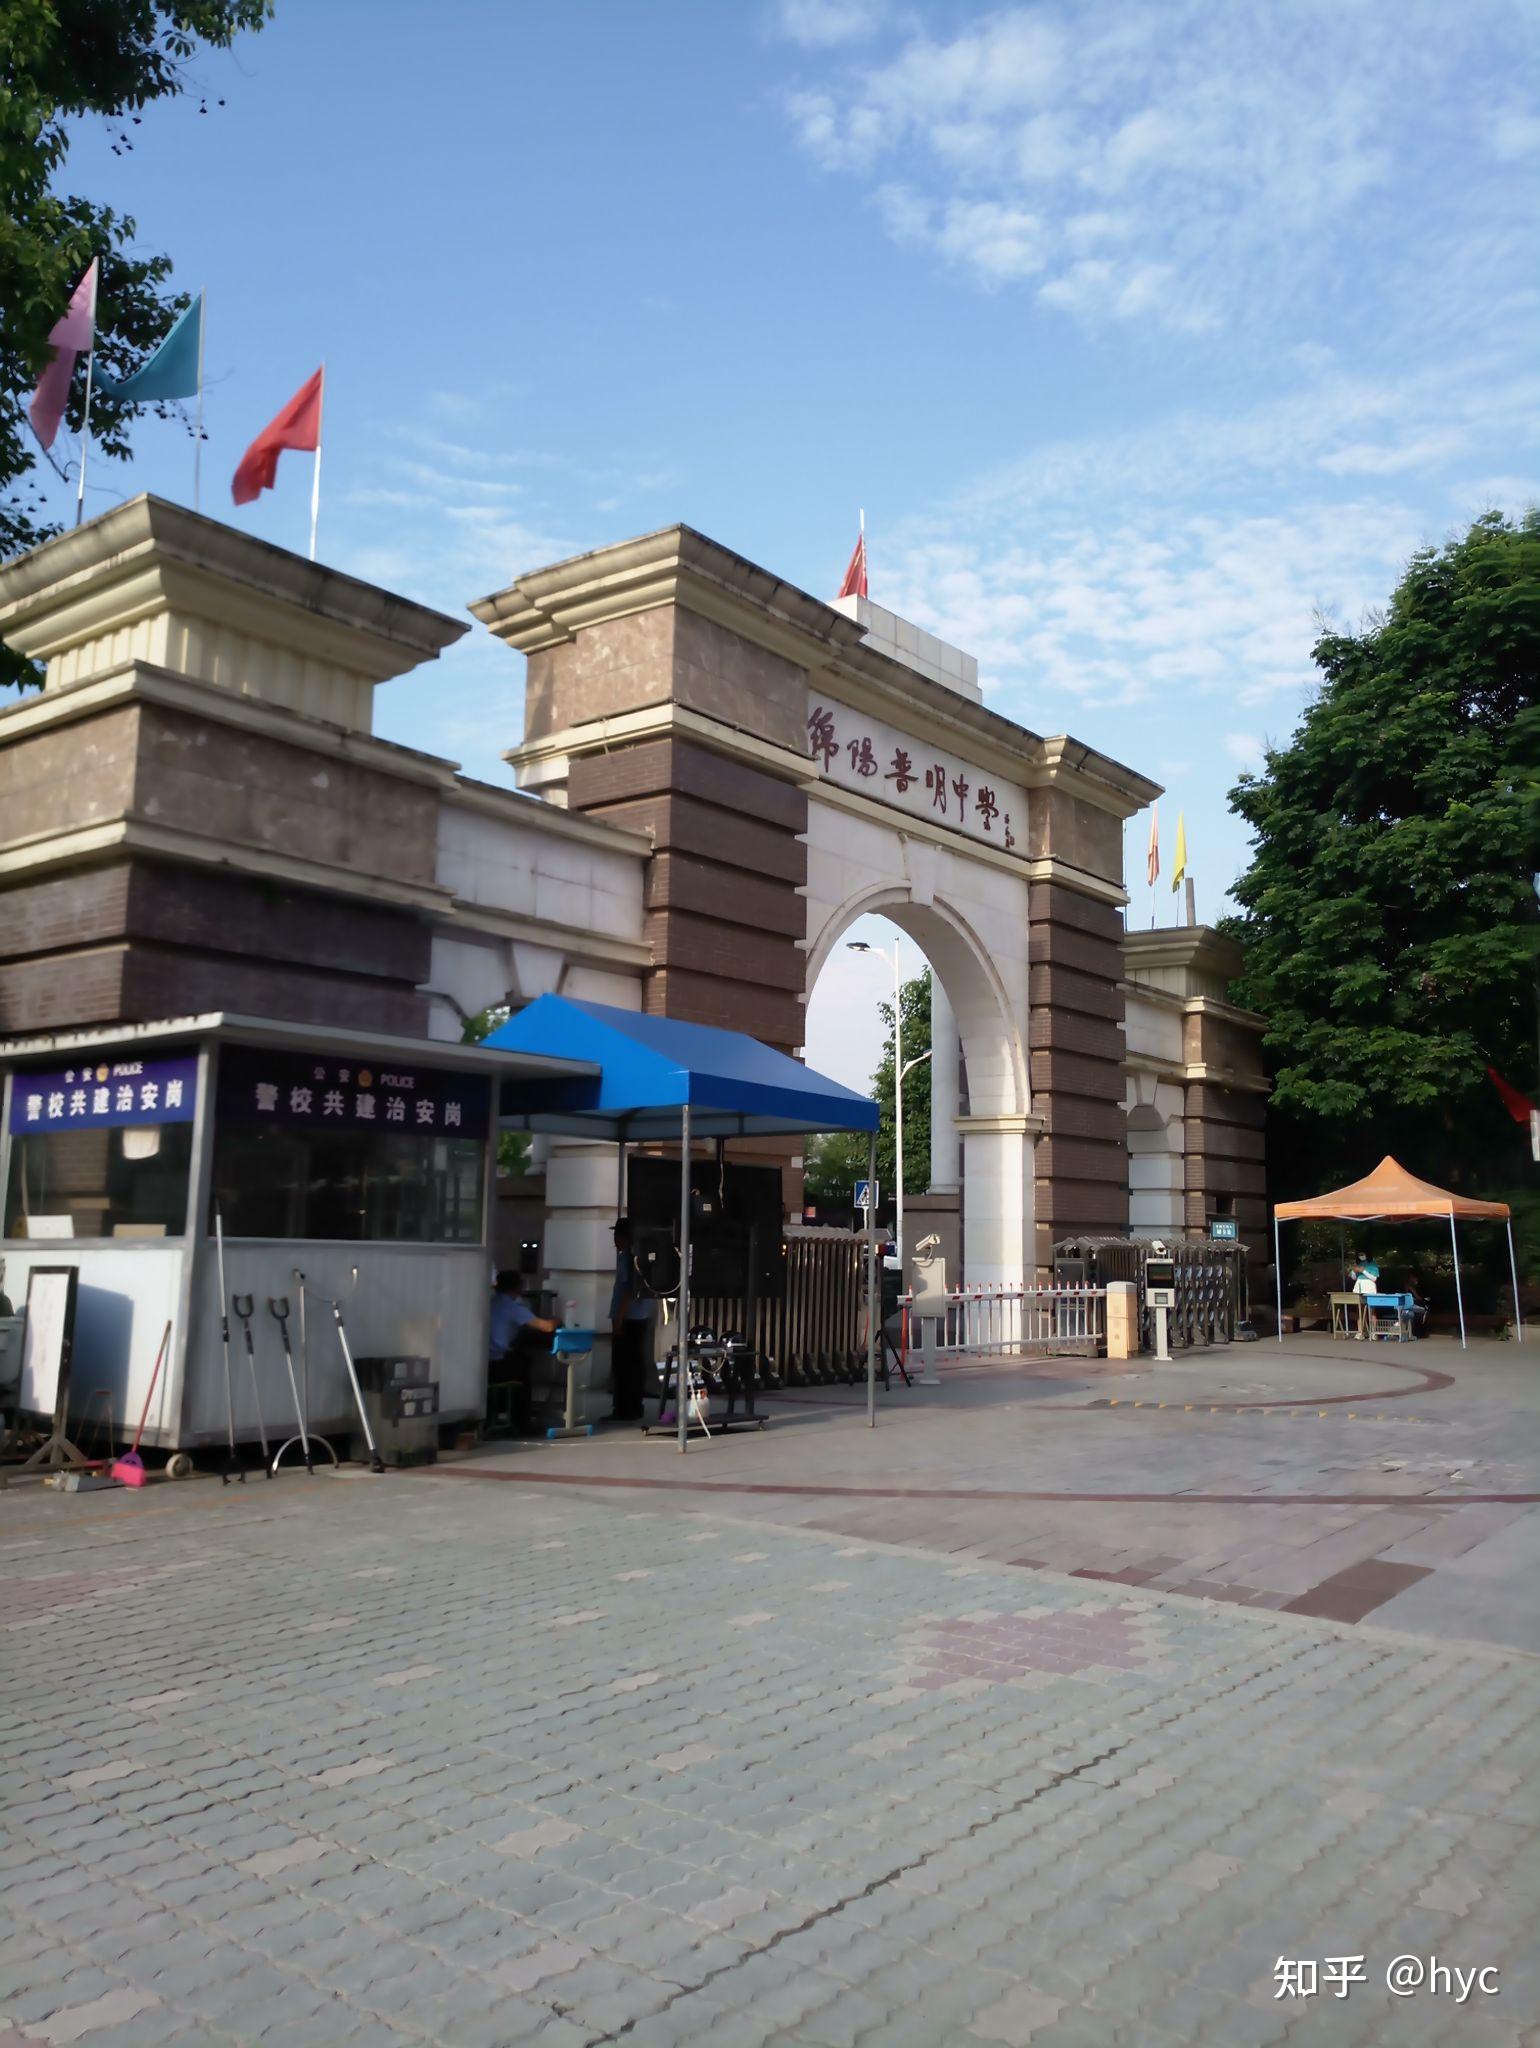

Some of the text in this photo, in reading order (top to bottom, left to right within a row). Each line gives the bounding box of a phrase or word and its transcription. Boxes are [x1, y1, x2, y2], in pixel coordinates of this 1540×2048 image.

[113, 1061, 143, 1077] POLICE
[380, 1073, 415, 1089] POLICE
[26, 1079, 183, 1121] 警校共建治安岗
[255, 1082, 462, 1126] 警校共建治安岗
